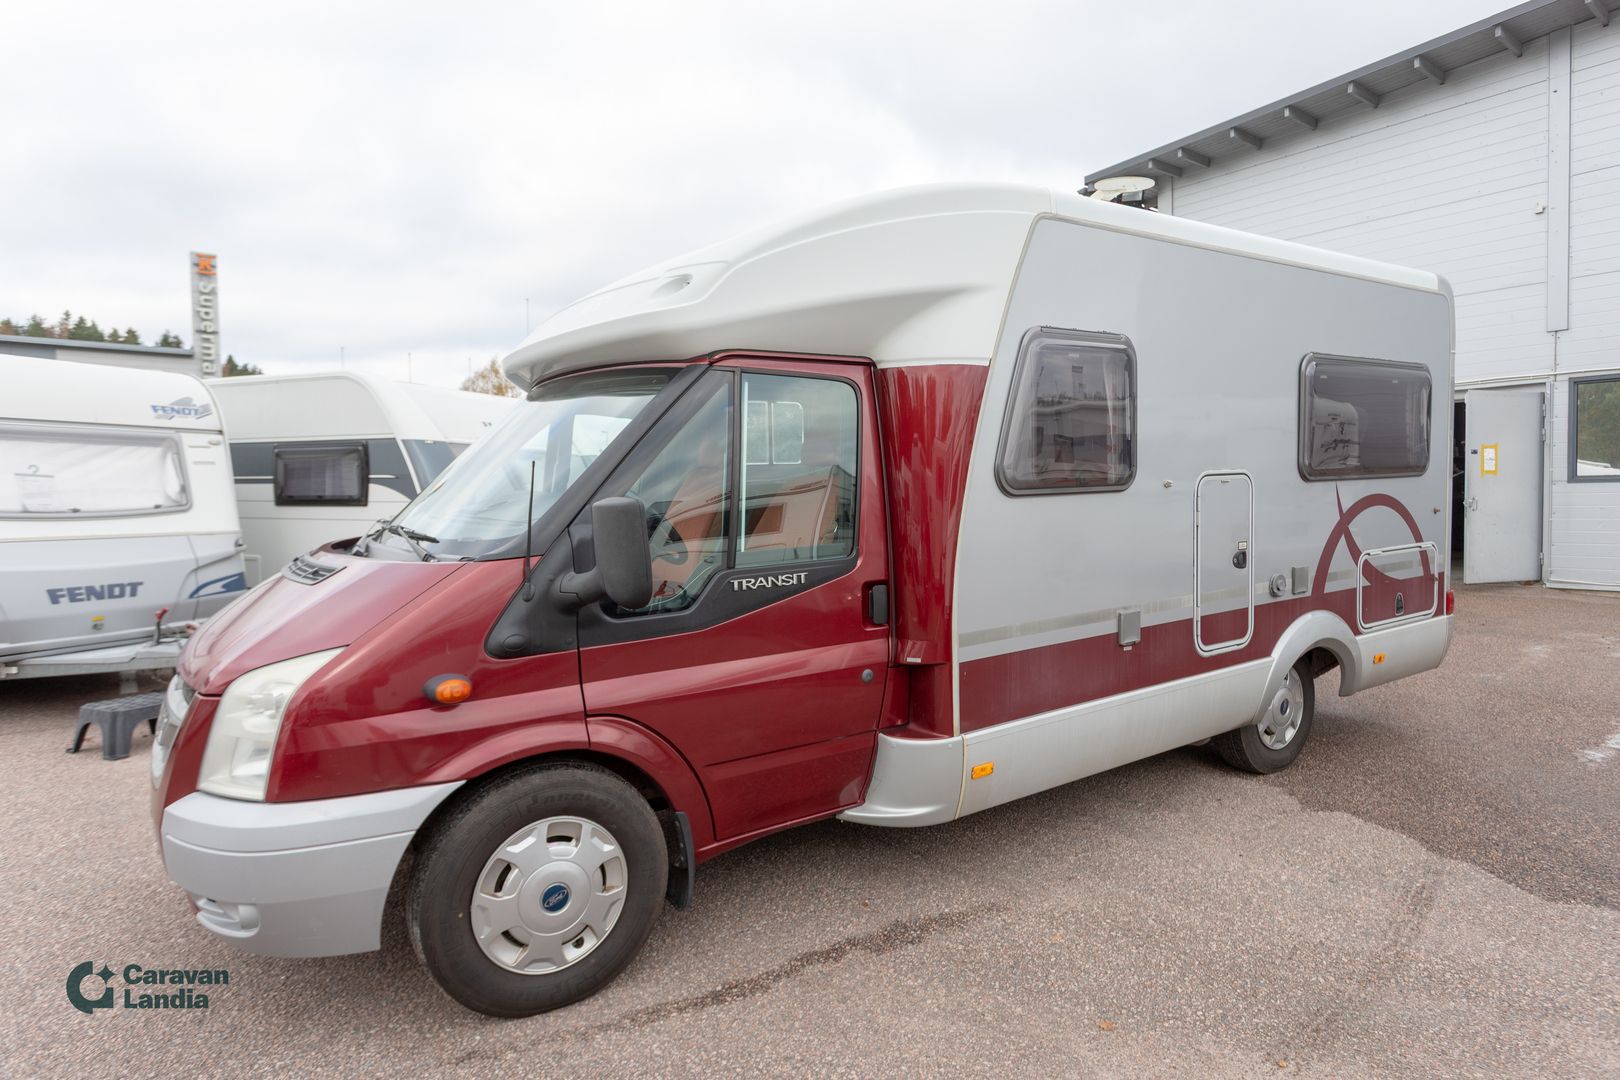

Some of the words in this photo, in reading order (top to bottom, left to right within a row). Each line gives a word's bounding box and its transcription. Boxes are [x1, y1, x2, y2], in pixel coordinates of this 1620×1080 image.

[197, 281, 216, 377] Superma
[151, 405, 200, 417] FENDT
[730, 572, 808, 591] TRANSIT
[46, 581, 144, 605] FENDT
